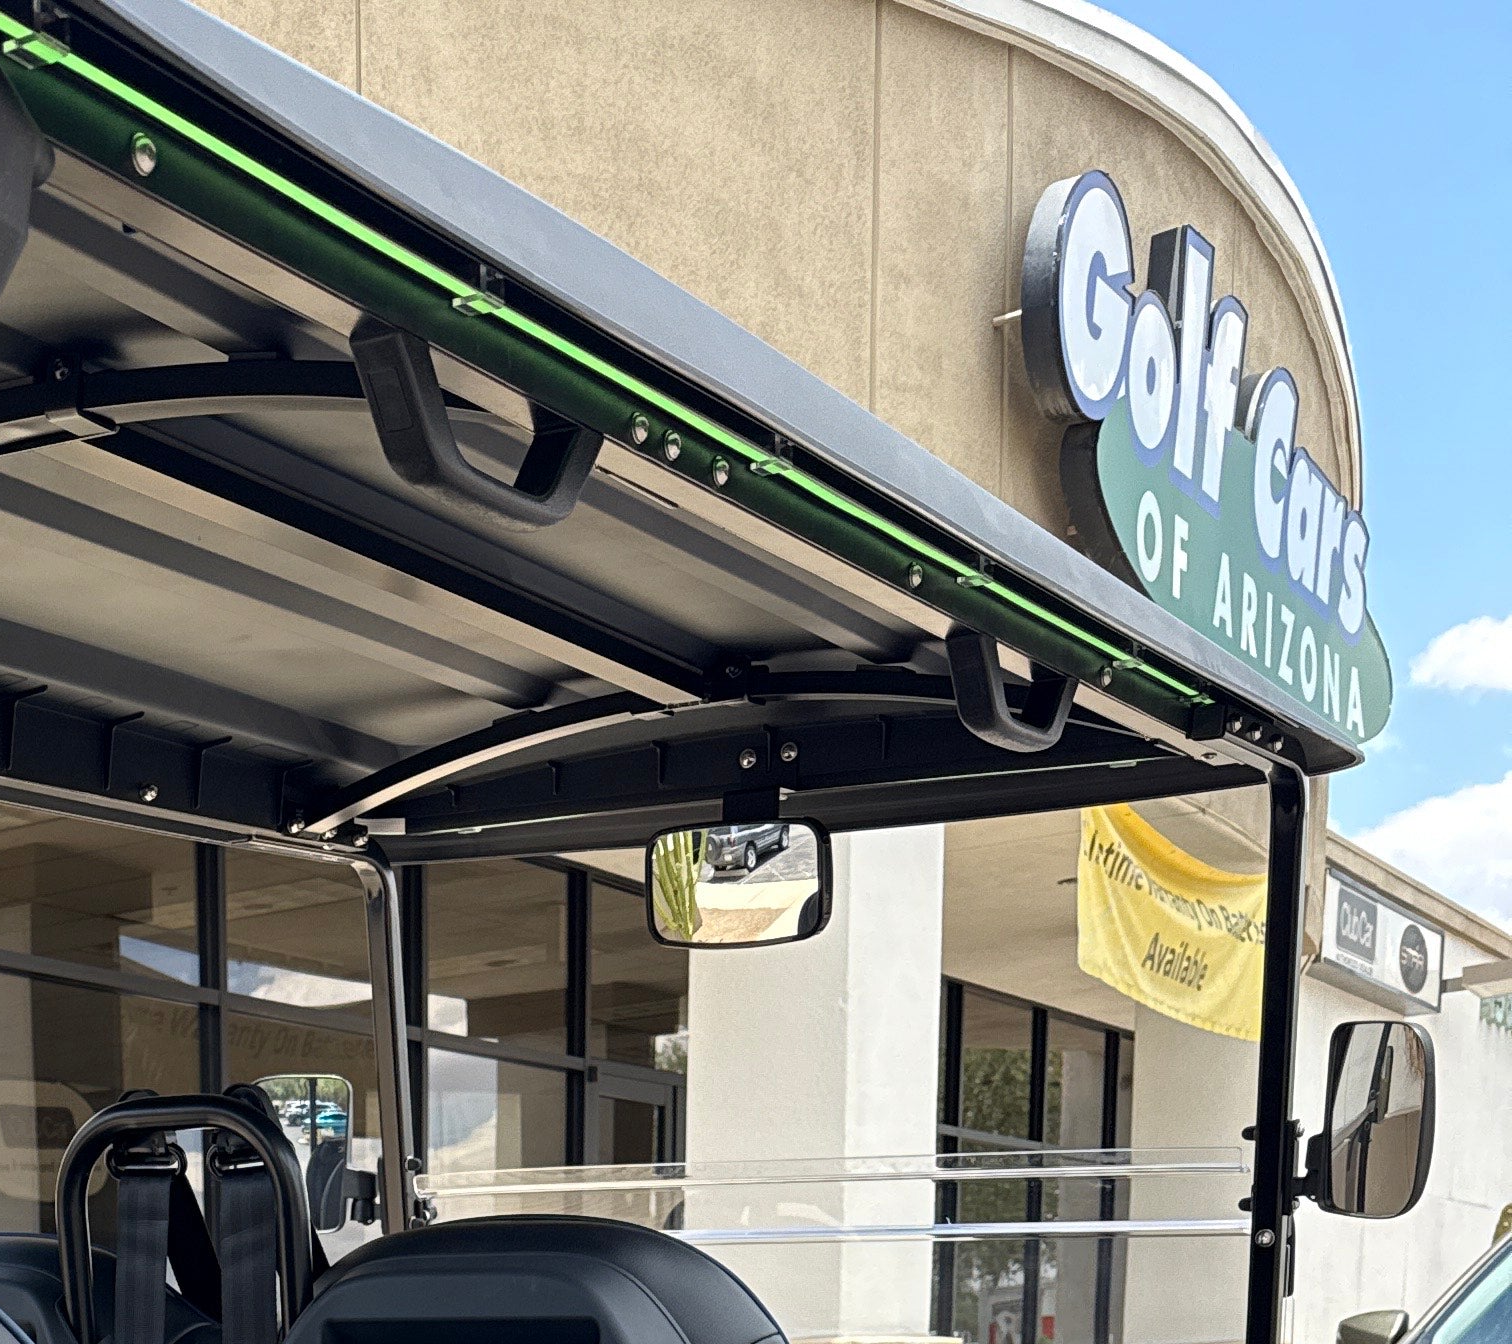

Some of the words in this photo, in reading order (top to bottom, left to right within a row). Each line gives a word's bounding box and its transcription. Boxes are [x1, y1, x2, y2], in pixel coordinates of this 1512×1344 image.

[1059, 172, 1247, 514] Golf
[1254, 370, 1368, 641] Cars
[1136, 490, 1189, 600] OF
[1212, 552, 1366, 738] ARIZONA
[1142, 932, 1208, 991] Available
